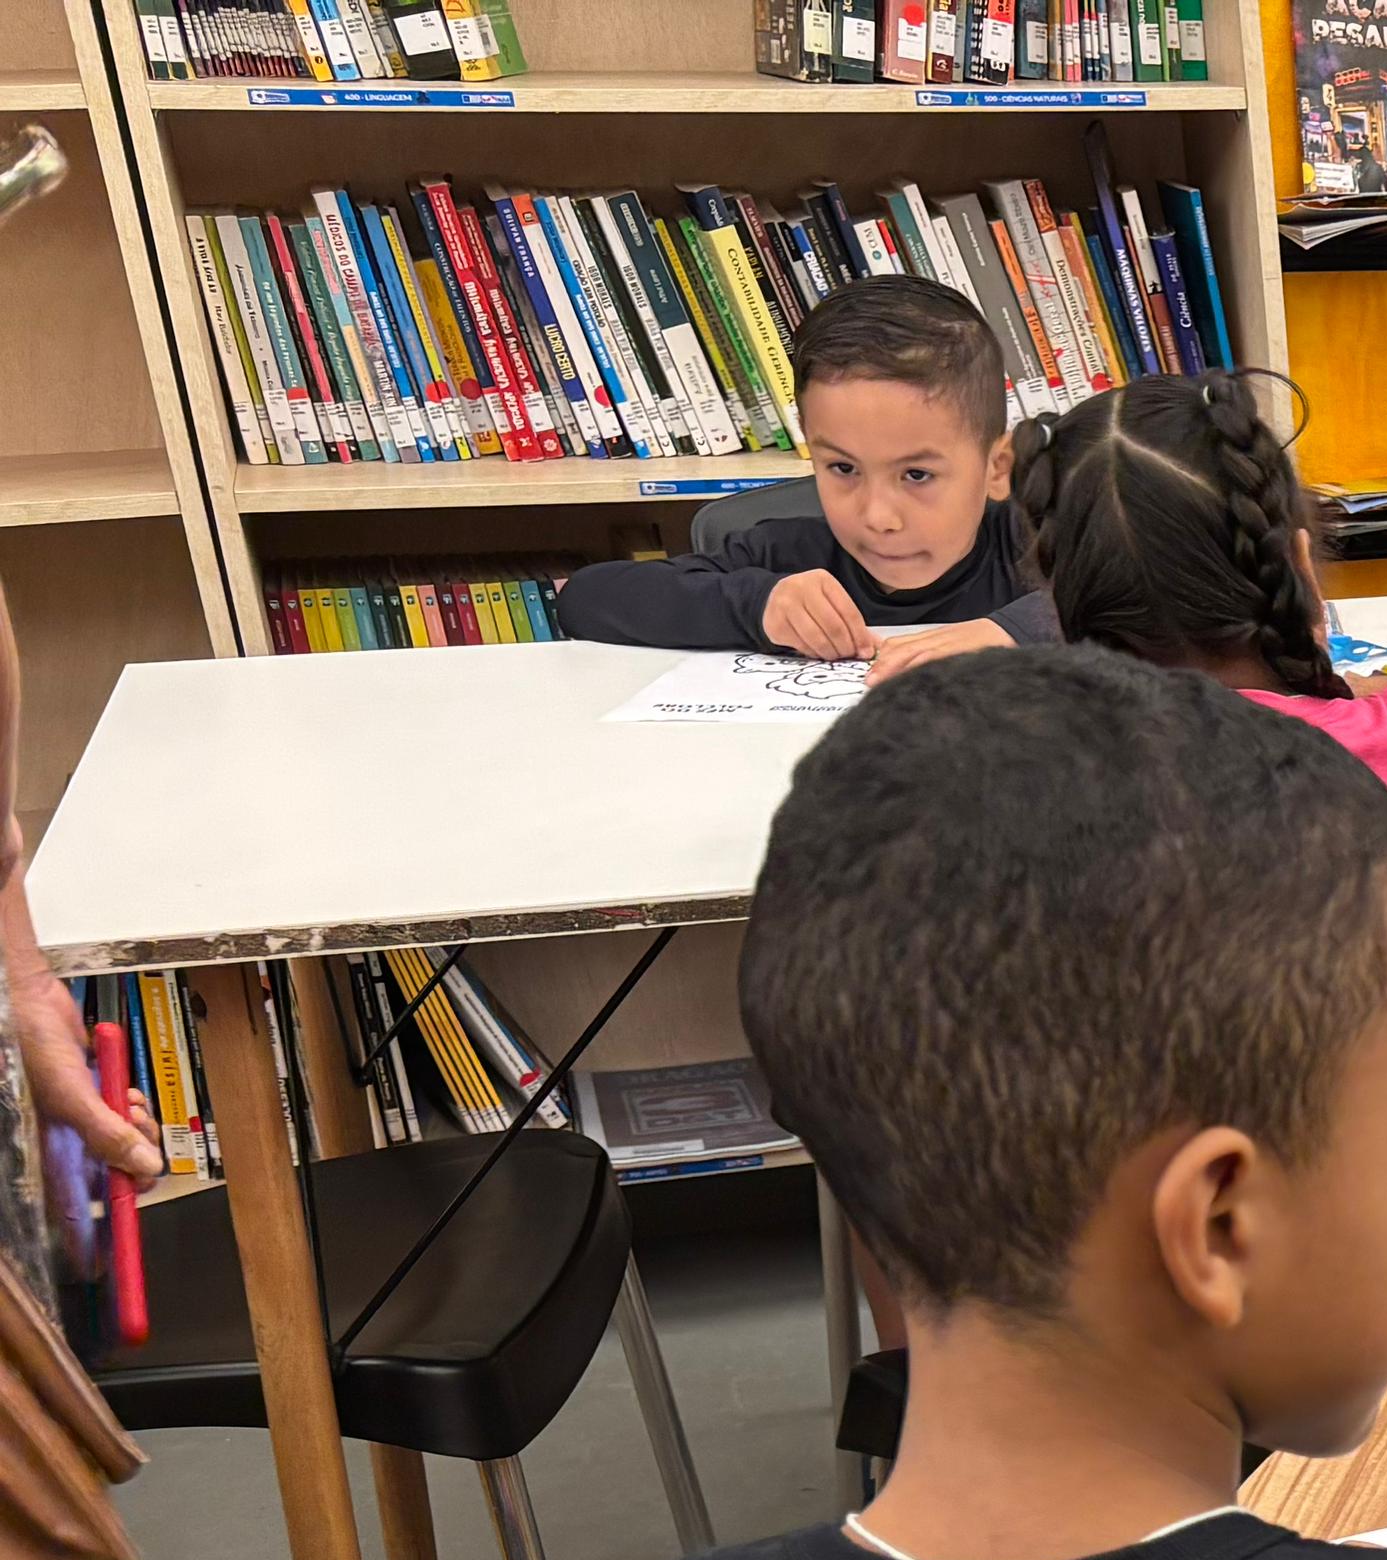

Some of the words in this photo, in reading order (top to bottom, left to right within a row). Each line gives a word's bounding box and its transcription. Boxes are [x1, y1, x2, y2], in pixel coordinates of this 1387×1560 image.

[1051, 258, 1092, 338] Demonstrações
[1113, 247, 1141, 307] MÁQUINAS
[725, 246, 773, 344] CONTABILIDADE
[765, 345, 799, 408] GERENCIA
[1173, 290, 1192, 328] Ciência
[543, 322, 565, 353] LUCRO
[554, 350, 575, 381] CERTO
